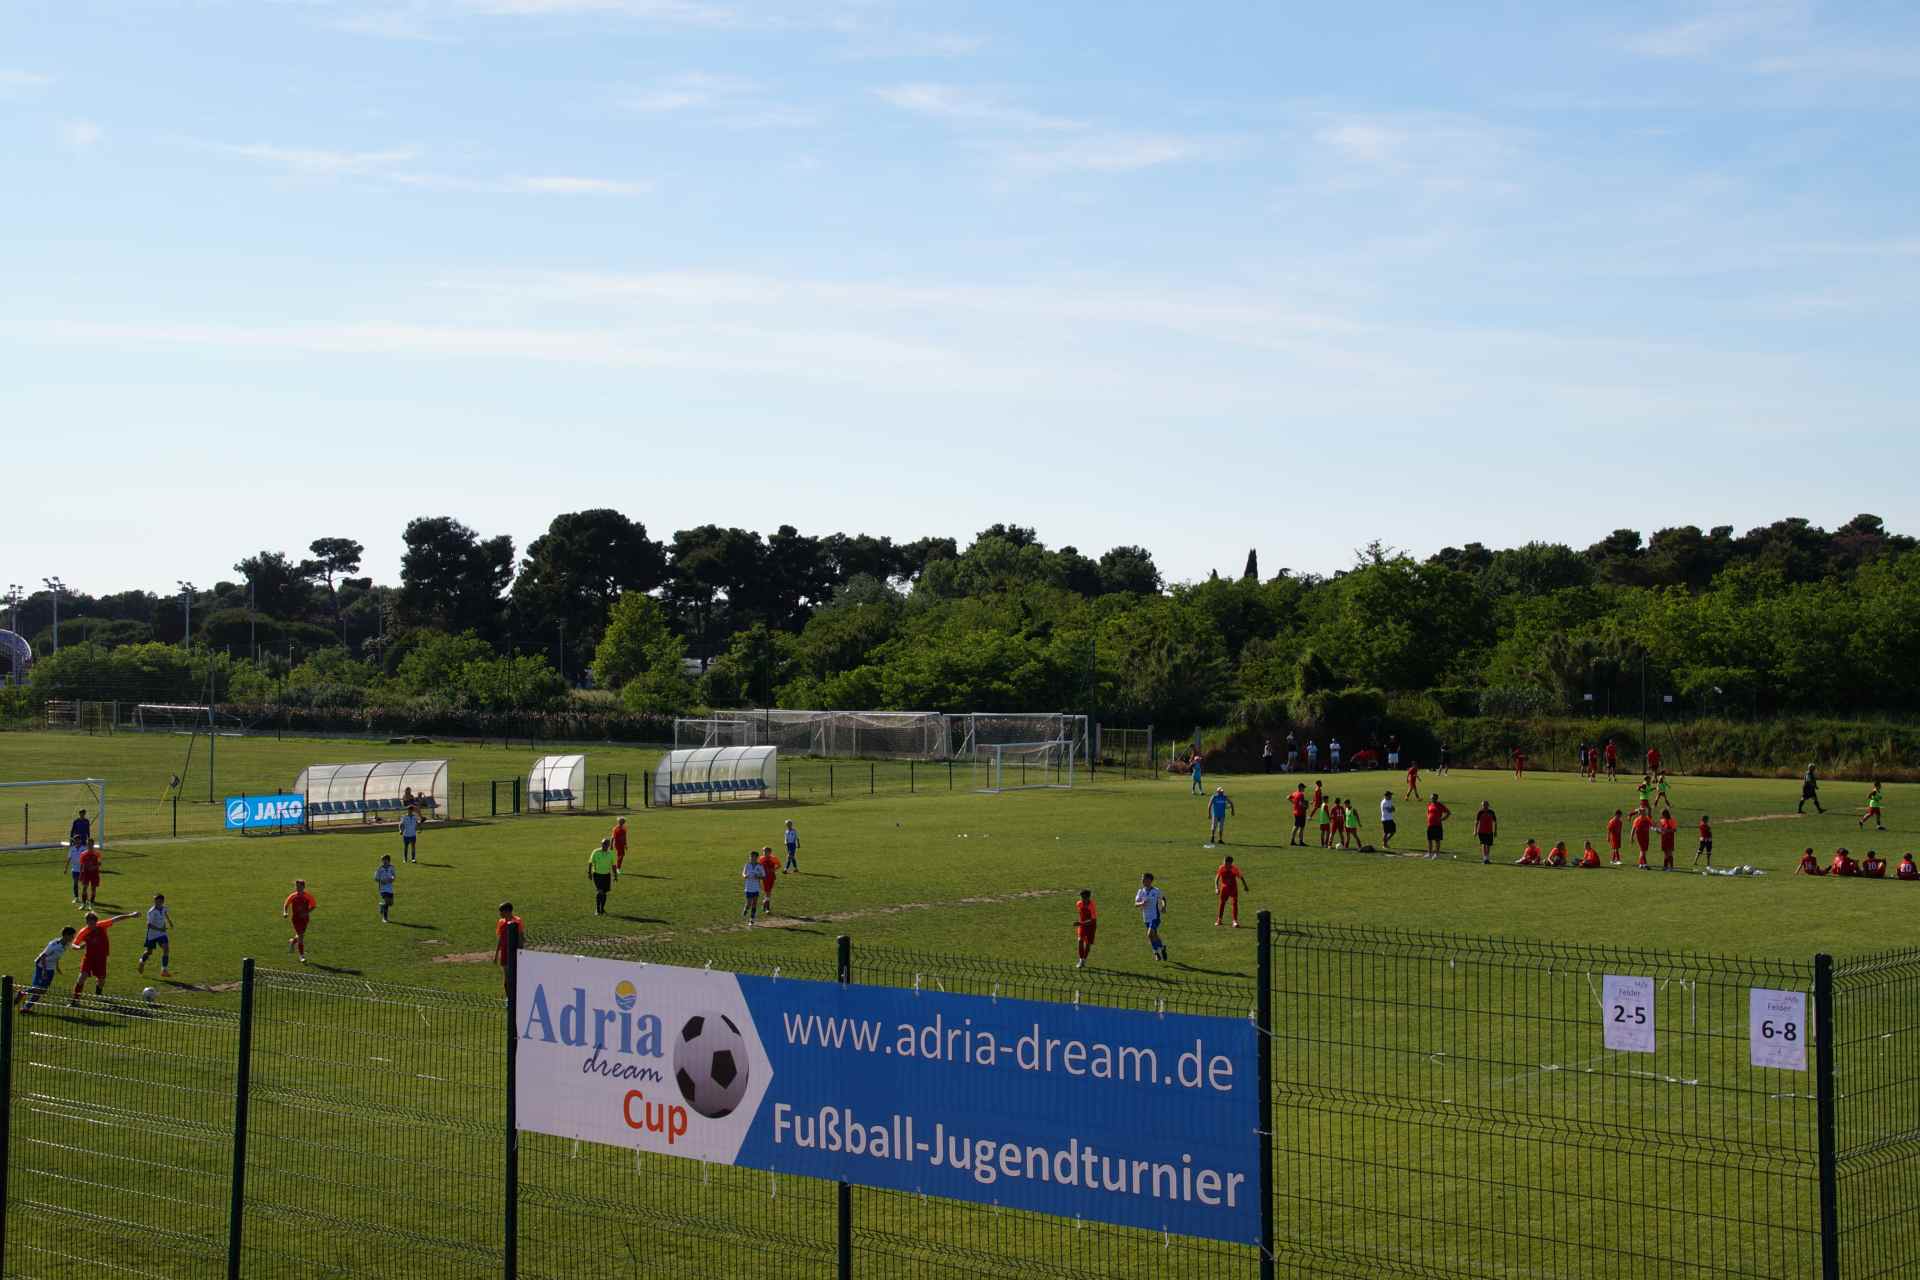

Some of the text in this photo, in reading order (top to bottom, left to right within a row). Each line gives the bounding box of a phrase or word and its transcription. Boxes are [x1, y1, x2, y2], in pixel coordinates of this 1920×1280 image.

[254, 800, 302, 821] JAKO
[523, 982, 664, 1059] Adria
[1614, 1004, 1646, 1025] 2-5
[1762, 1019, 1797, 1042] 6-8
[582, 1044, 664, 1083] dream
[784, 1011, 1234, 1093] www.adria-dream.de
[623, 1090, 688, 1145] Cup
[774, 1103, 1246, 1210] Fußball-Jugendturnier
